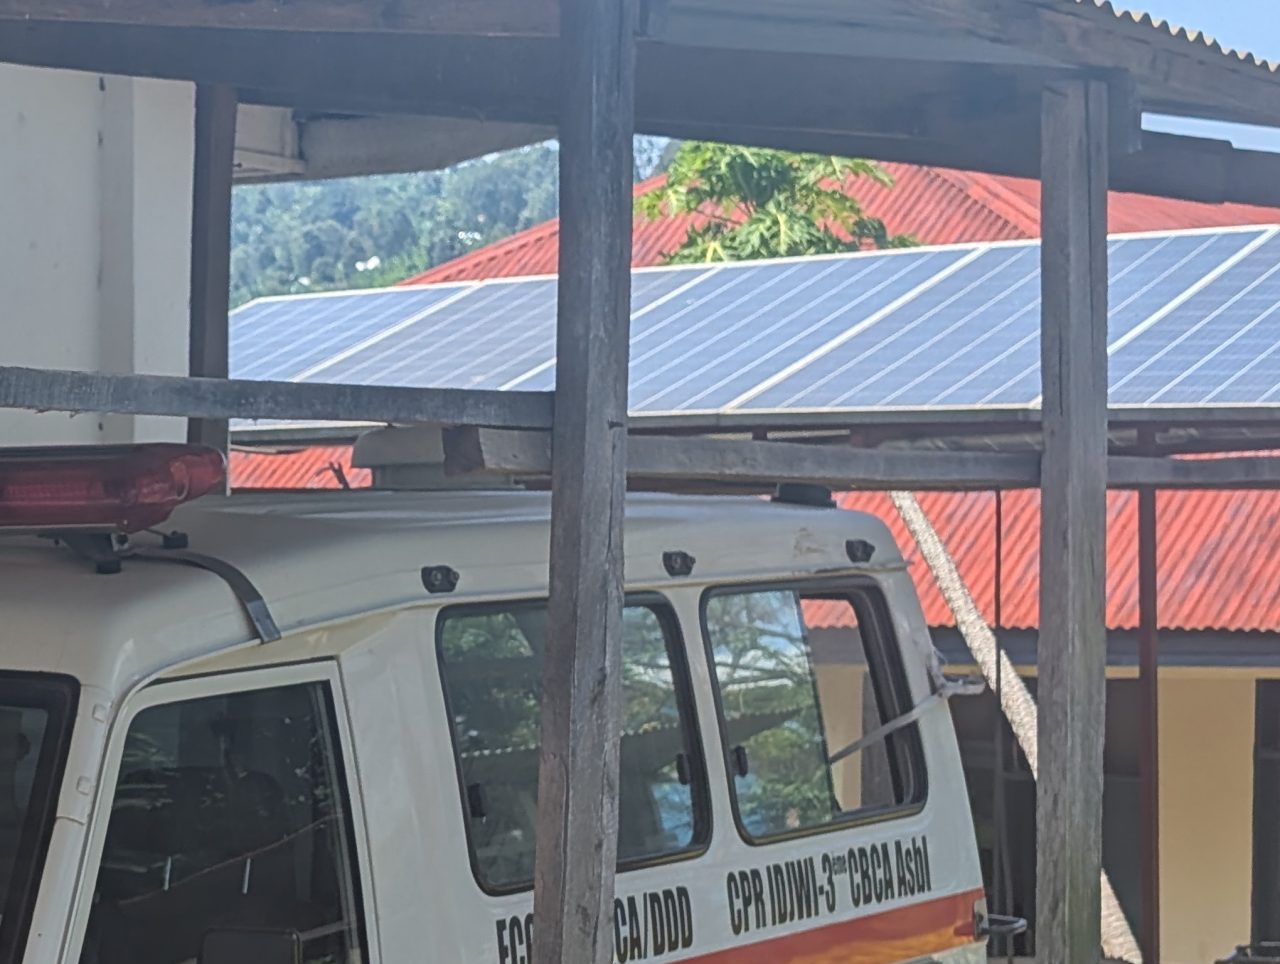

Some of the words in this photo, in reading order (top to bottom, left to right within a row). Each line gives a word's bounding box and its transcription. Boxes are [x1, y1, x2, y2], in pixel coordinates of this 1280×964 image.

[611, 886, 694, 964] CA/DDD
[726, 868, 767, 936] CPR
[847, 842, 895, 908] CBCA
